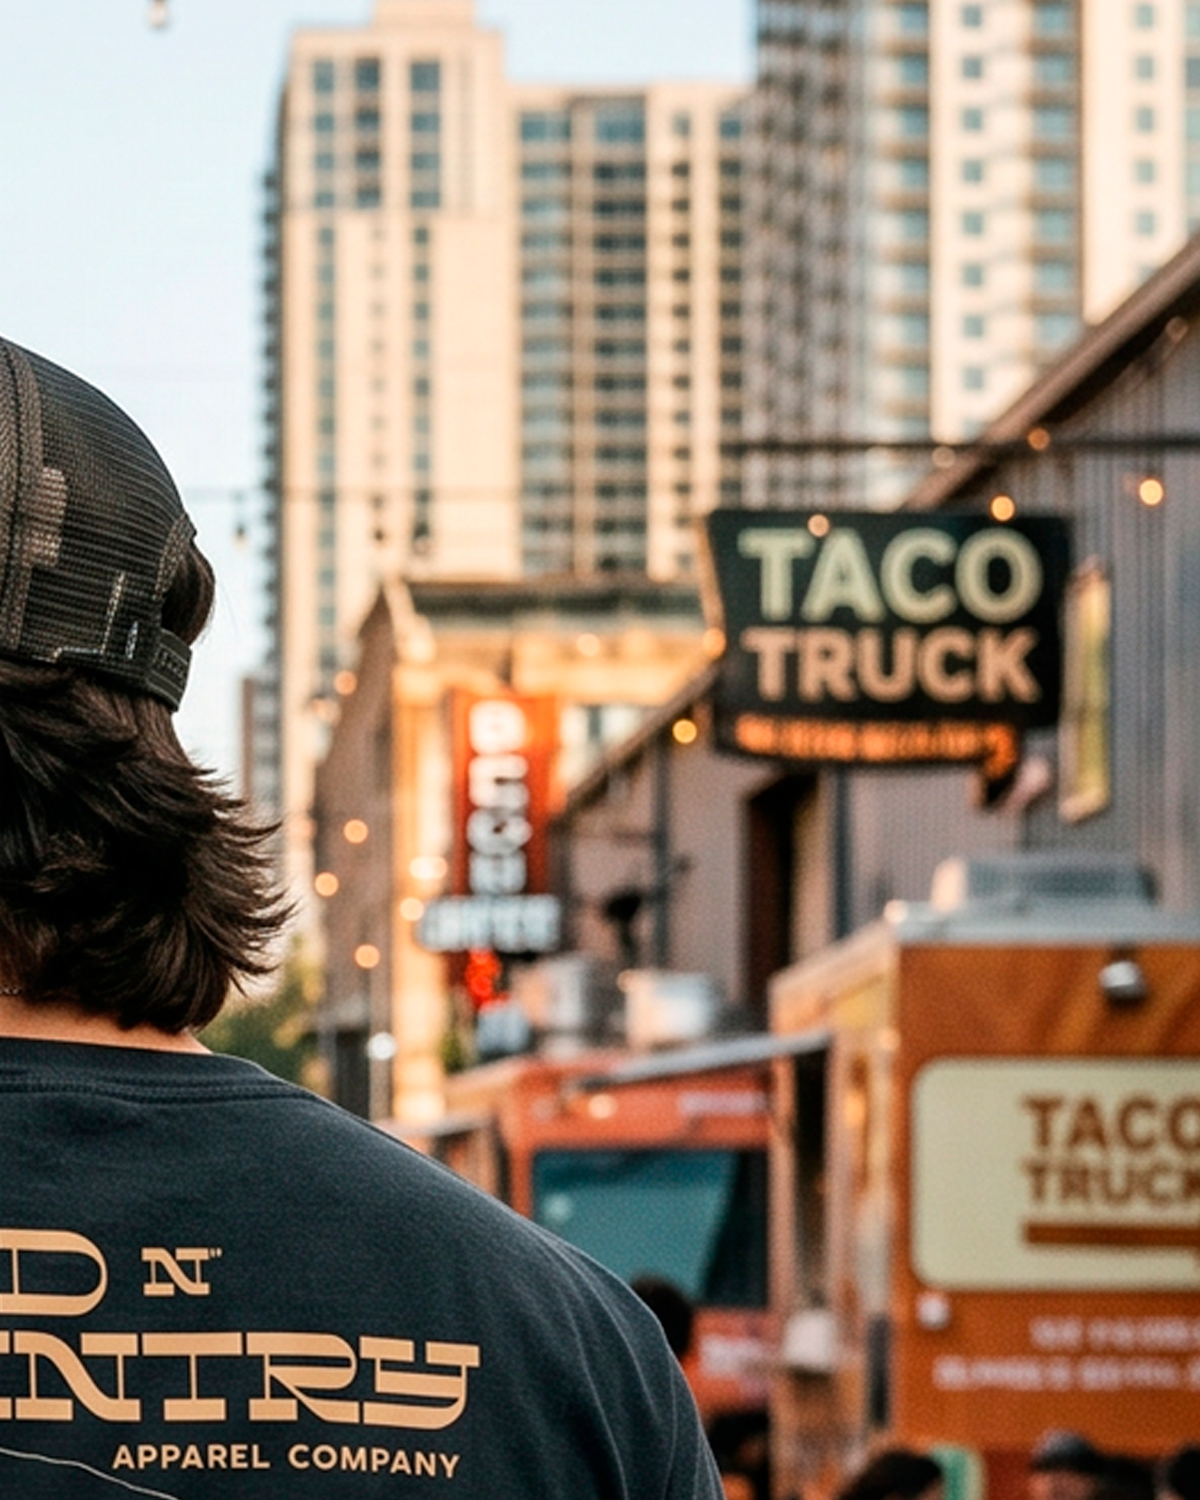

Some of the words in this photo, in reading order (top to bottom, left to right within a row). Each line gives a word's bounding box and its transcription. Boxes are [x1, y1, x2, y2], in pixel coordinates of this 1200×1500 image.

[737, 525, 1044, 624] TACO
[740, 626, 1041, 702] TRUCK
[1019, 1092, 1200, 1154] TACO
[112, 1444, 271, 1469] APPAREL
[288, 1444, 460, 1478] COMPANY
